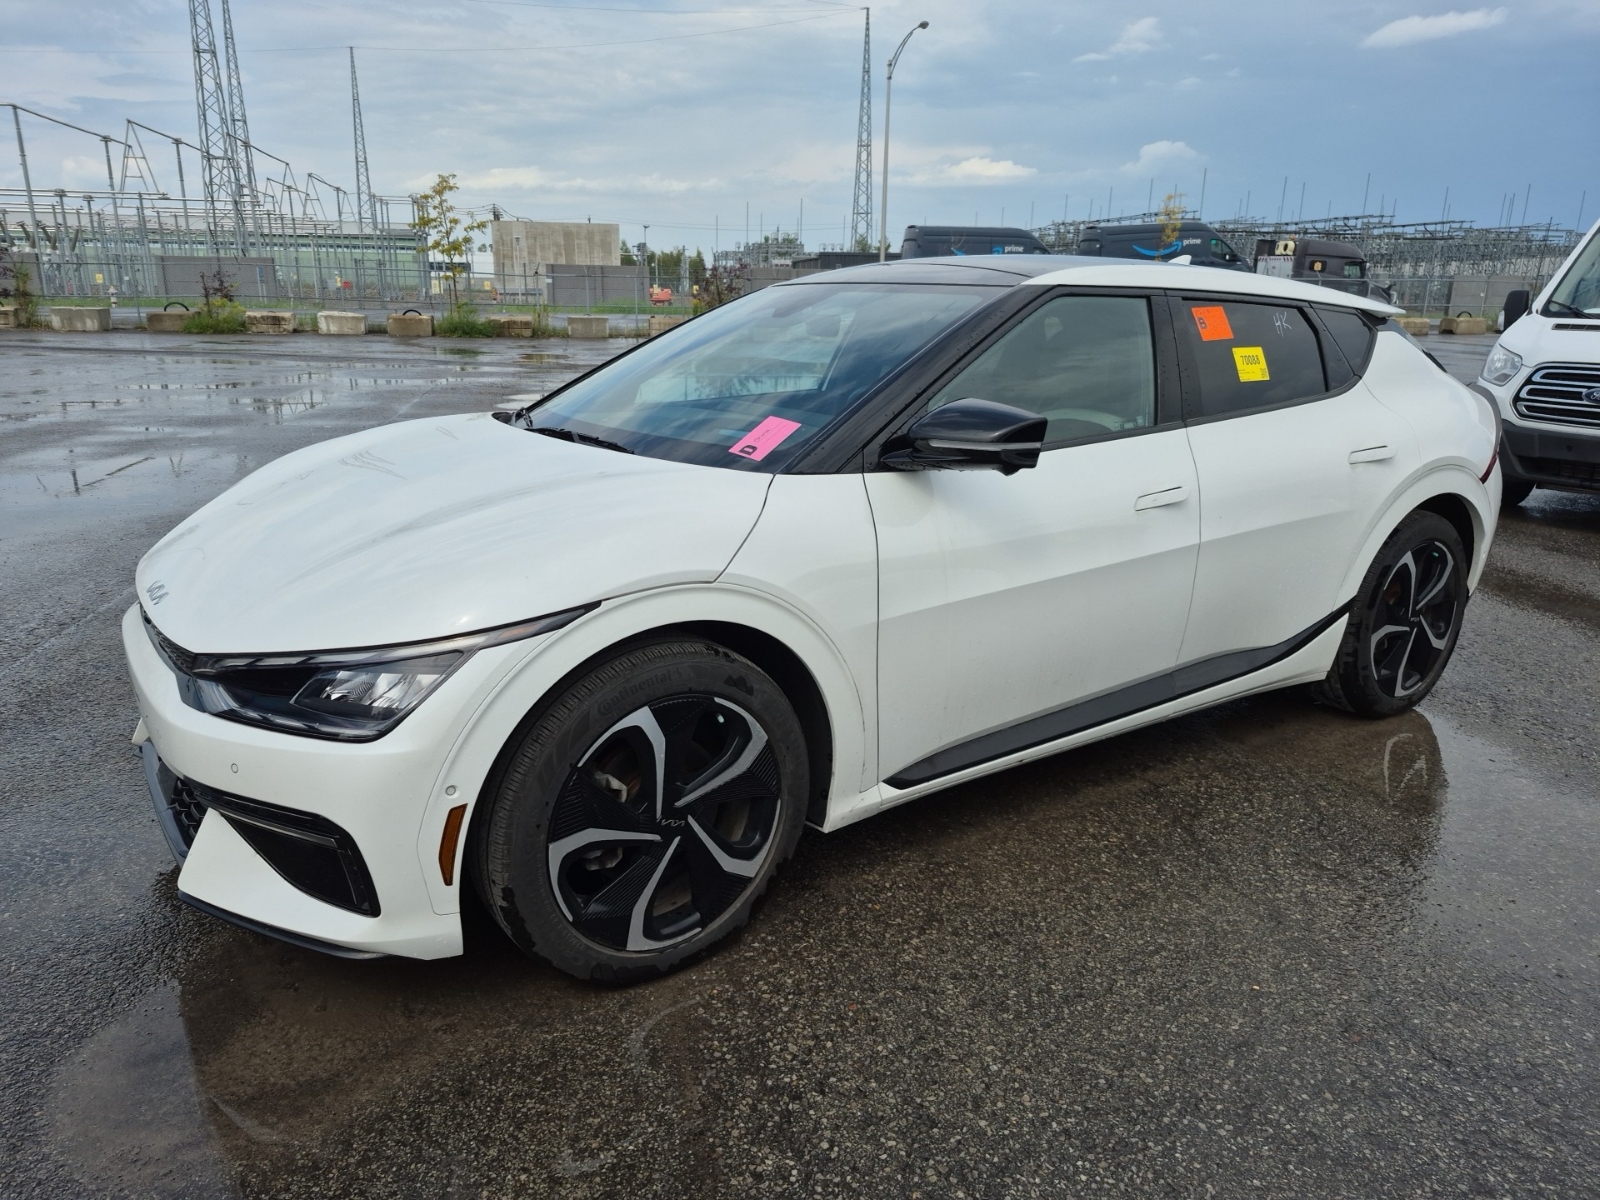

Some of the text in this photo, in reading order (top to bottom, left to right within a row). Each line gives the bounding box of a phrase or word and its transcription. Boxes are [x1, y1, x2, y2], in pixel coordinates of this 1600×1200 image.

[1183, 237, 1202, 247] prime
[1005, 244, 1024, 254] prime
[1197, 317, 1207, 329] B
[738, 444, 758, 456] D
[597, 668, 673, 717] Continental
